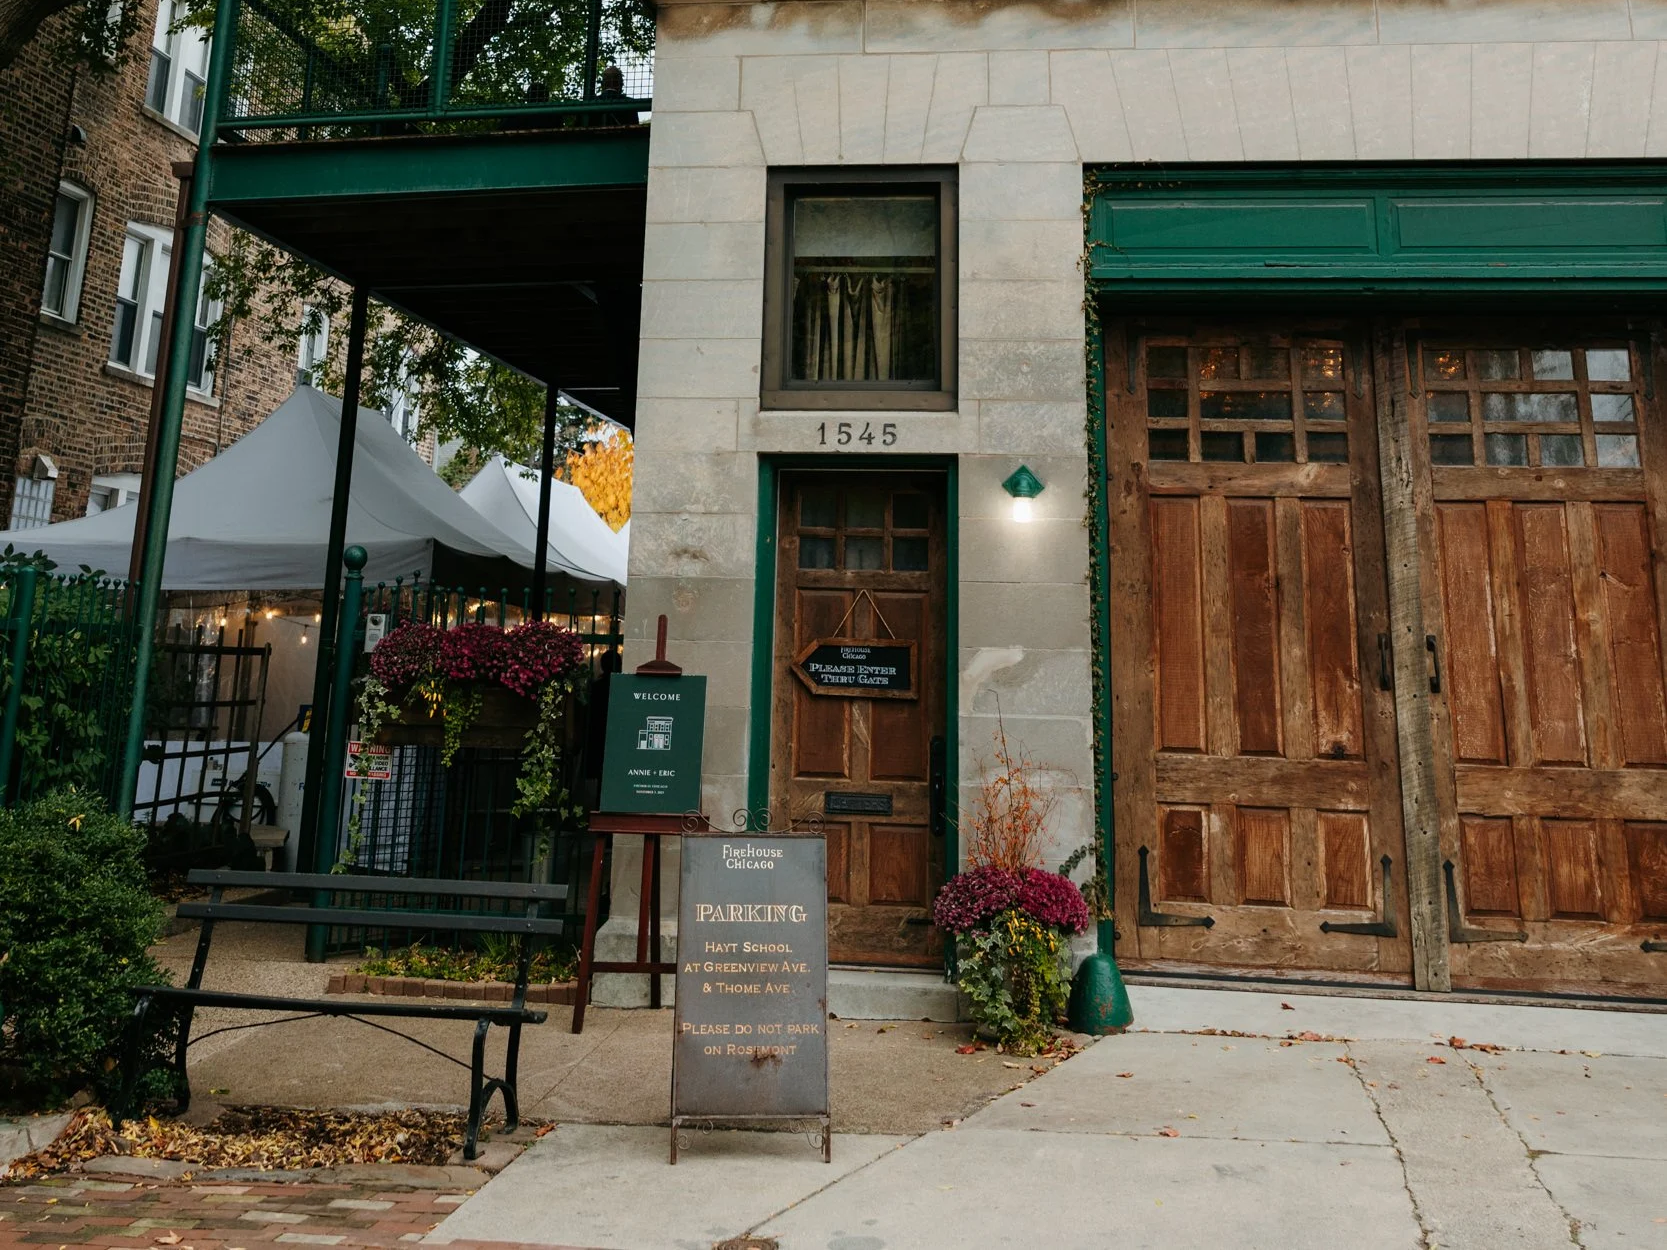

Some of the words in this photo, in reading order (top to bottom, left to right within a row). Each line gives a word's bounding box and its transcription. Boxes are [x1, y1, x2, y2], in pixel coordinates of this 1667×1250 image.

[817, 422, 897, 446] 1545
[809, 663, 855, 673] PLEASE
[857, 665, 897, 675] ENTER
[821, 674, 855, 684] THRU
[857, 674, 889, 685] GATE
[633, 692, 681, 701] WELCOME
[351, 744, 391, 754] WNING
[658, 769, 676, 777] ERIC
[722, 844, 783, 859] FIREHOUSE
[726, 858, 774, 869] CHICAGO
[695, 903, 808, 923] PARKING
[705, 941, 738, 953] HAYT
[743, 941, 793, 953] SCHOOL
[684, 963, 701, 973] AT
[703, 961, 779, 973] GREENVIEW
[781, 961, 811, 973] AVE.
[702, 982, 712, 993] &
[715, 982, 761, 994] THOME
[682, 1022, 730, 1035] PLEASE
[735, 1024, 752, 1035] DO
[758, 1024, 782, 1034] NOT
[787, 1024, 820, 1034] PARK
[704, 1045, 721, 1055] ON
[727, 1044, 797, 1055] ROSEMONT
